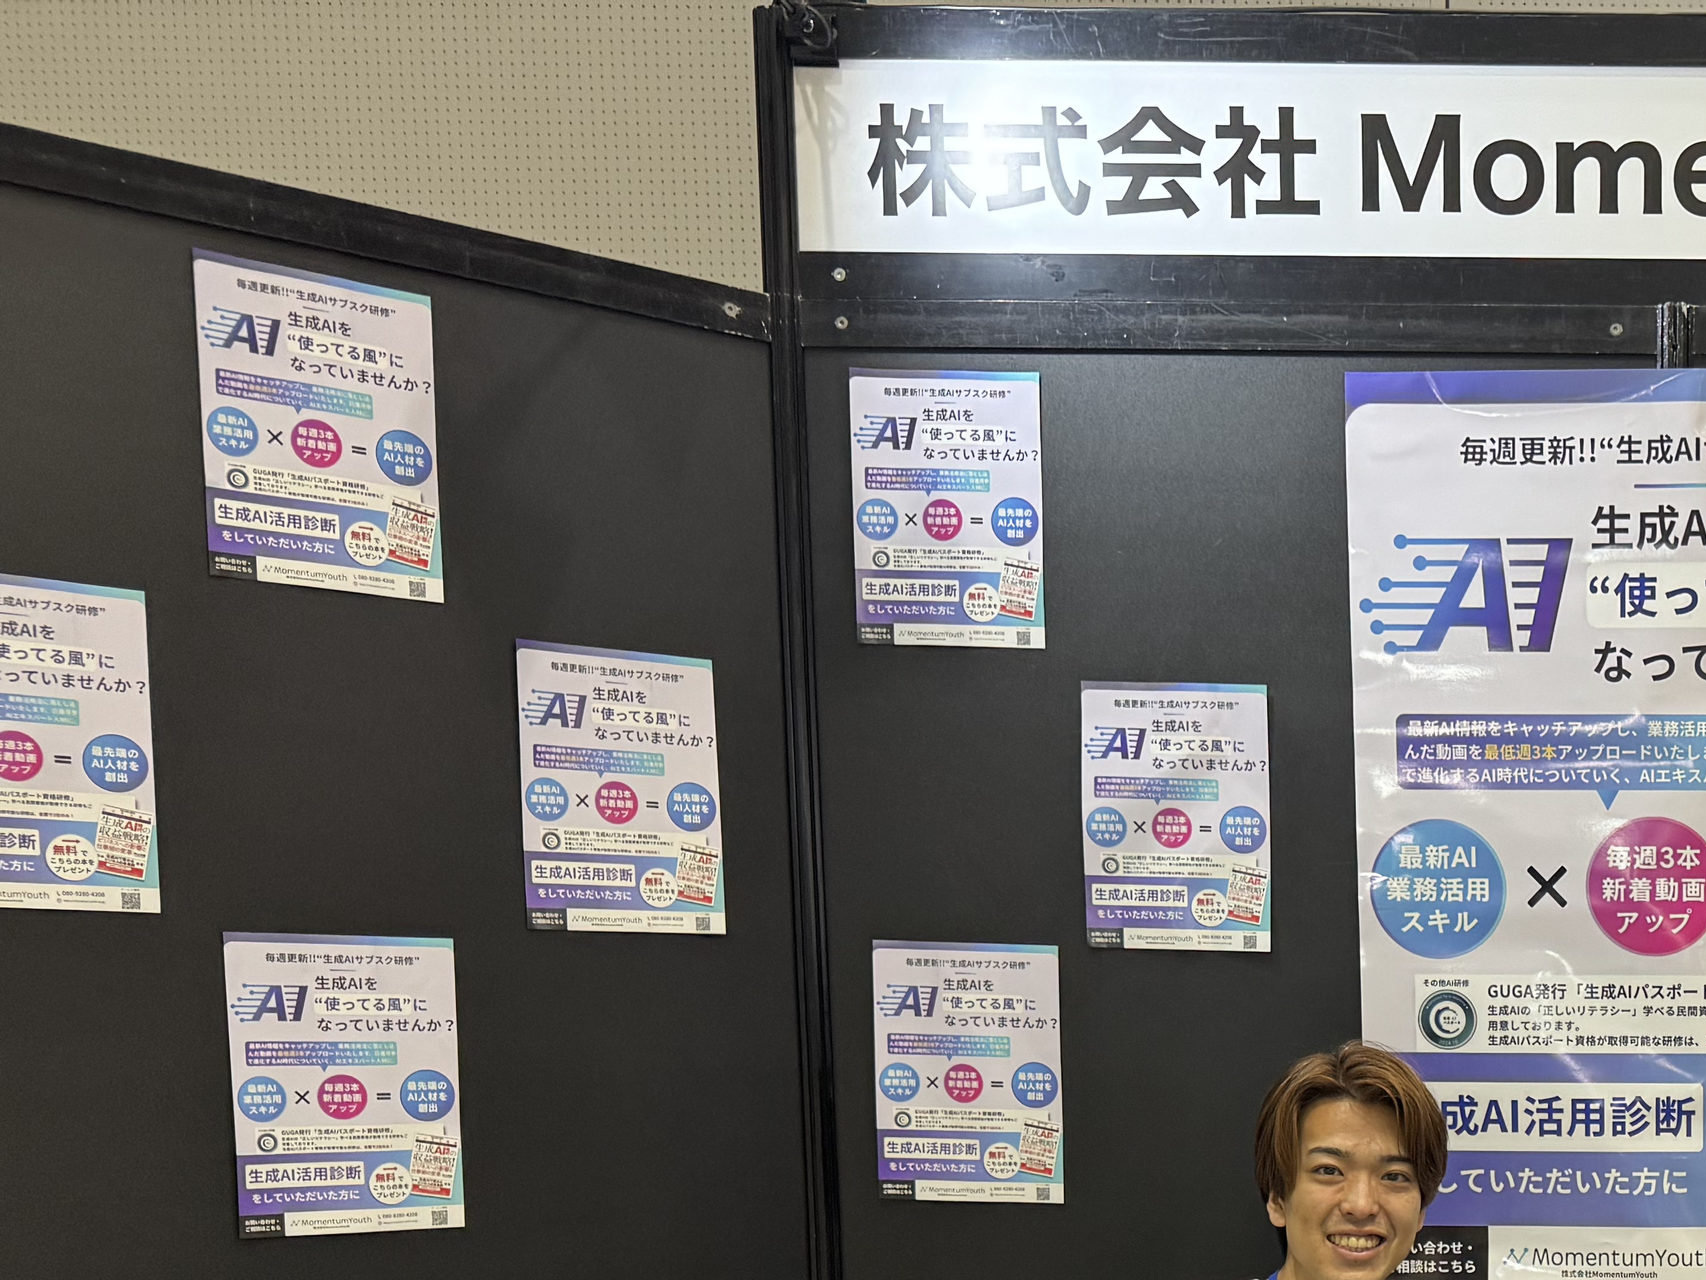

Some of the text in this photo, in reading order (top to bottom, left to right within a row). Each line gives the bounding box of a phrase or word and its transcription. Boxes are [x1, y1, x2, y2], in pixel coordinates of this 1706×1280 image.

[867, 101, 1319, 220] 株式会社
[286, 310, 352, 338] 生成AIを
[290, 356, 431, 396] なっていませんか？
[922, 408, 974, 422] 生成AIを
[923, 447, 1039, 462] なっていませんか？
[217, 503, 337, 535] 生成AI活用診断
[865, 582, 958, 598] 生成AI活用診断
[0, 666, 147, 695] っていませんか？
[592, 686, 647, 704] 生成AIを
[1151, 719, 1203, 733] 生成AIを
[595, 727, 714, 748] なっていませんか？
[1153, 758, 1267, 772] なっていませんか？
[1398, 845, 1477, 869] 最新AI
[1606, 844, 1701, 870] 毎週3本
[534, 864, 634, 882] 生成AI活用診断
[1094, 888, 1186, 903] 生成AI活用診断
[1386, 877, 1490, 902] 業務活用
[1602, 877, 1706, 903] 新着動画
[1400, 910, 1479, 933] スキル
[1616, 910, 1692, 934] アップ
[314, 975, 378, 990] 生成AIを
[943, 978, 994, 991] 生成AIを
[317, 1019, 454, 1032] なっていませんか？
[945, 1015, 1059, 1029] なっていませんか？
[1487, 1020, 1581, 1032] 用意しております。
[887, 1141, 978, 1156] 生成AI活用診断
[247, 1165, 362, 1185] 生成AI活用診断
[1392, 1260, 1476, 1274] 相談はこちら
[1561, 1270, 1658, 1279] 株式会社MomentumYouth
